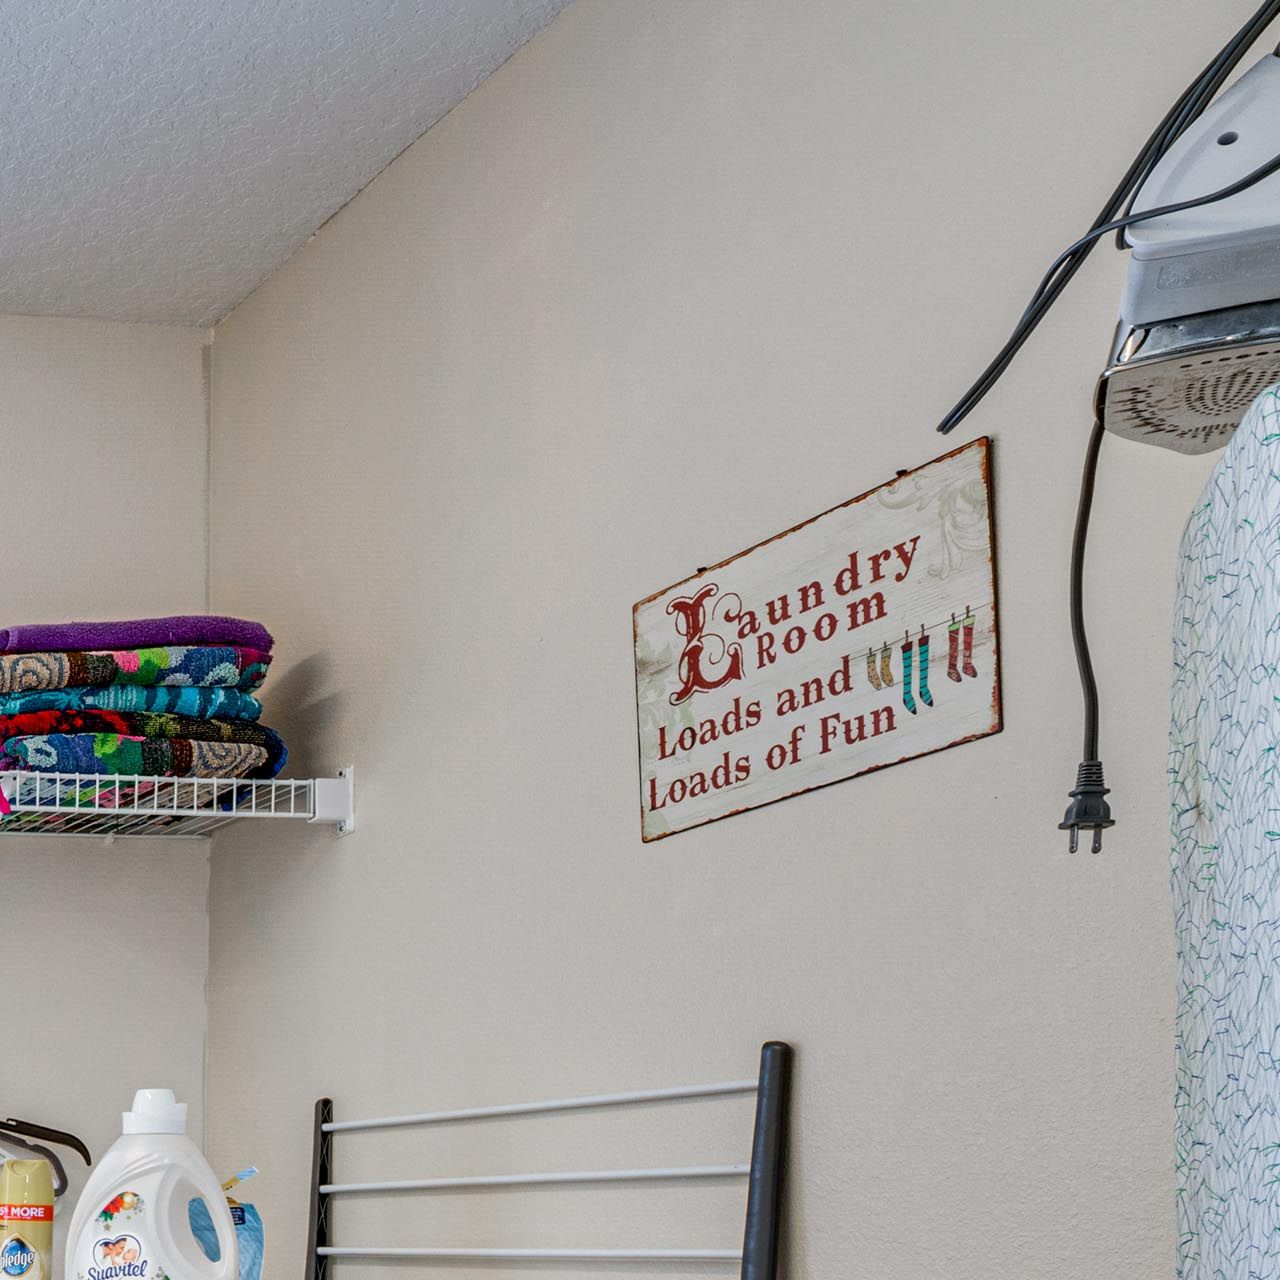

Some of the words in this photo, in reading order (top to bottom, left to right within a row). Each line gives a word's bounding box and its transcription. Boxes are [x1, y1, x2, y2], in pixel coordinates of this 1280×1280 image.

[666, 536, 921, 706] Laundry
[648, 752, 752, 812] Loads
[765, 726, 806, 772] of
[819, 704, 897, 755] Fun
[658, 698, 761, 760] Loads
[776, 655, 854, 717] and
[0, 1250, 35, 1272] pledge
[11, 1207, 45, 1218] MORE
